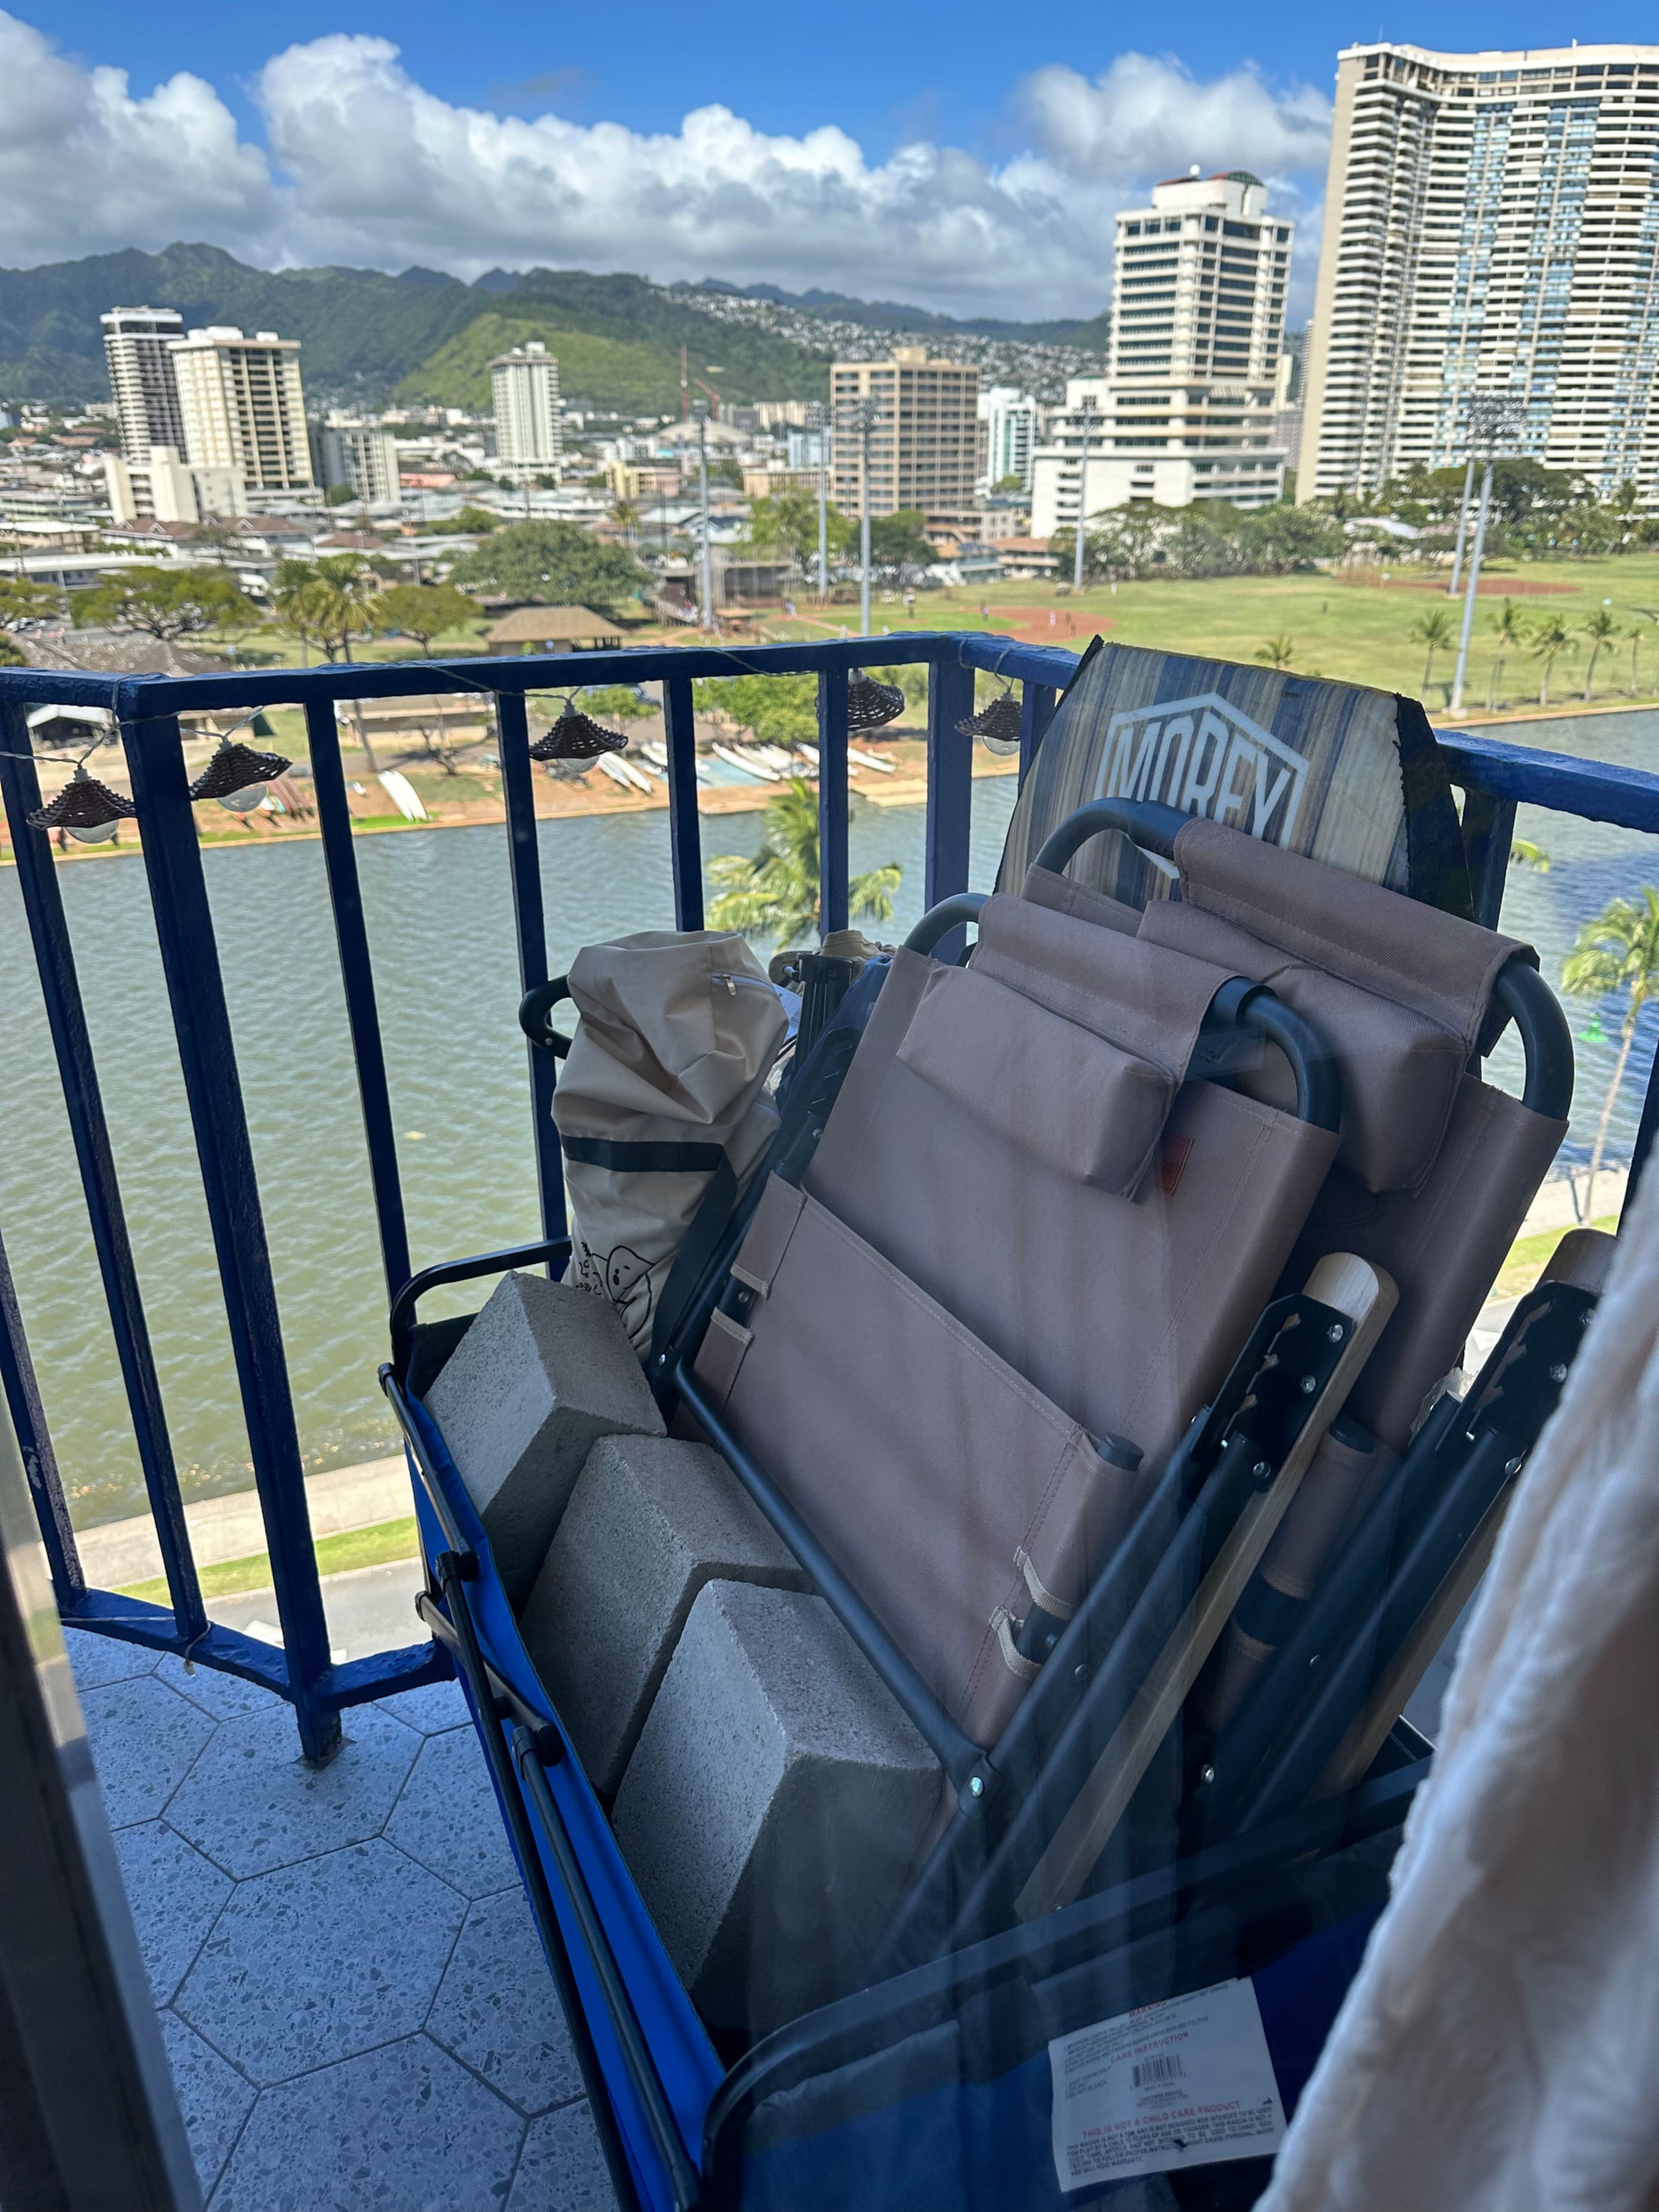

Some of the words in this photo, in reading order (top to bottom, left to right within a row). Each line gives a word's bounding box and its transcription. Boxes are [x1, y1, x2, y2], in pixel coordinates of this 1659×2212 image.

[1108, 707, 1292, 841] MOREY
[1110, 2050, 1131, 2062] CARE
[1134, 2031, 1189, 2053] INSTRUCTION
[1083, 2126, 1102, 2138] THIS
[1104, 2125, 1112, 2133] IS
[1115, 2120, 1131, 2131] NOT
[1143, 2112, 1169, 2124] CHILD
[1171, 2108, 1195, 2119] CARE
[1198, 2101, 1240, 2113] PRODUCT
